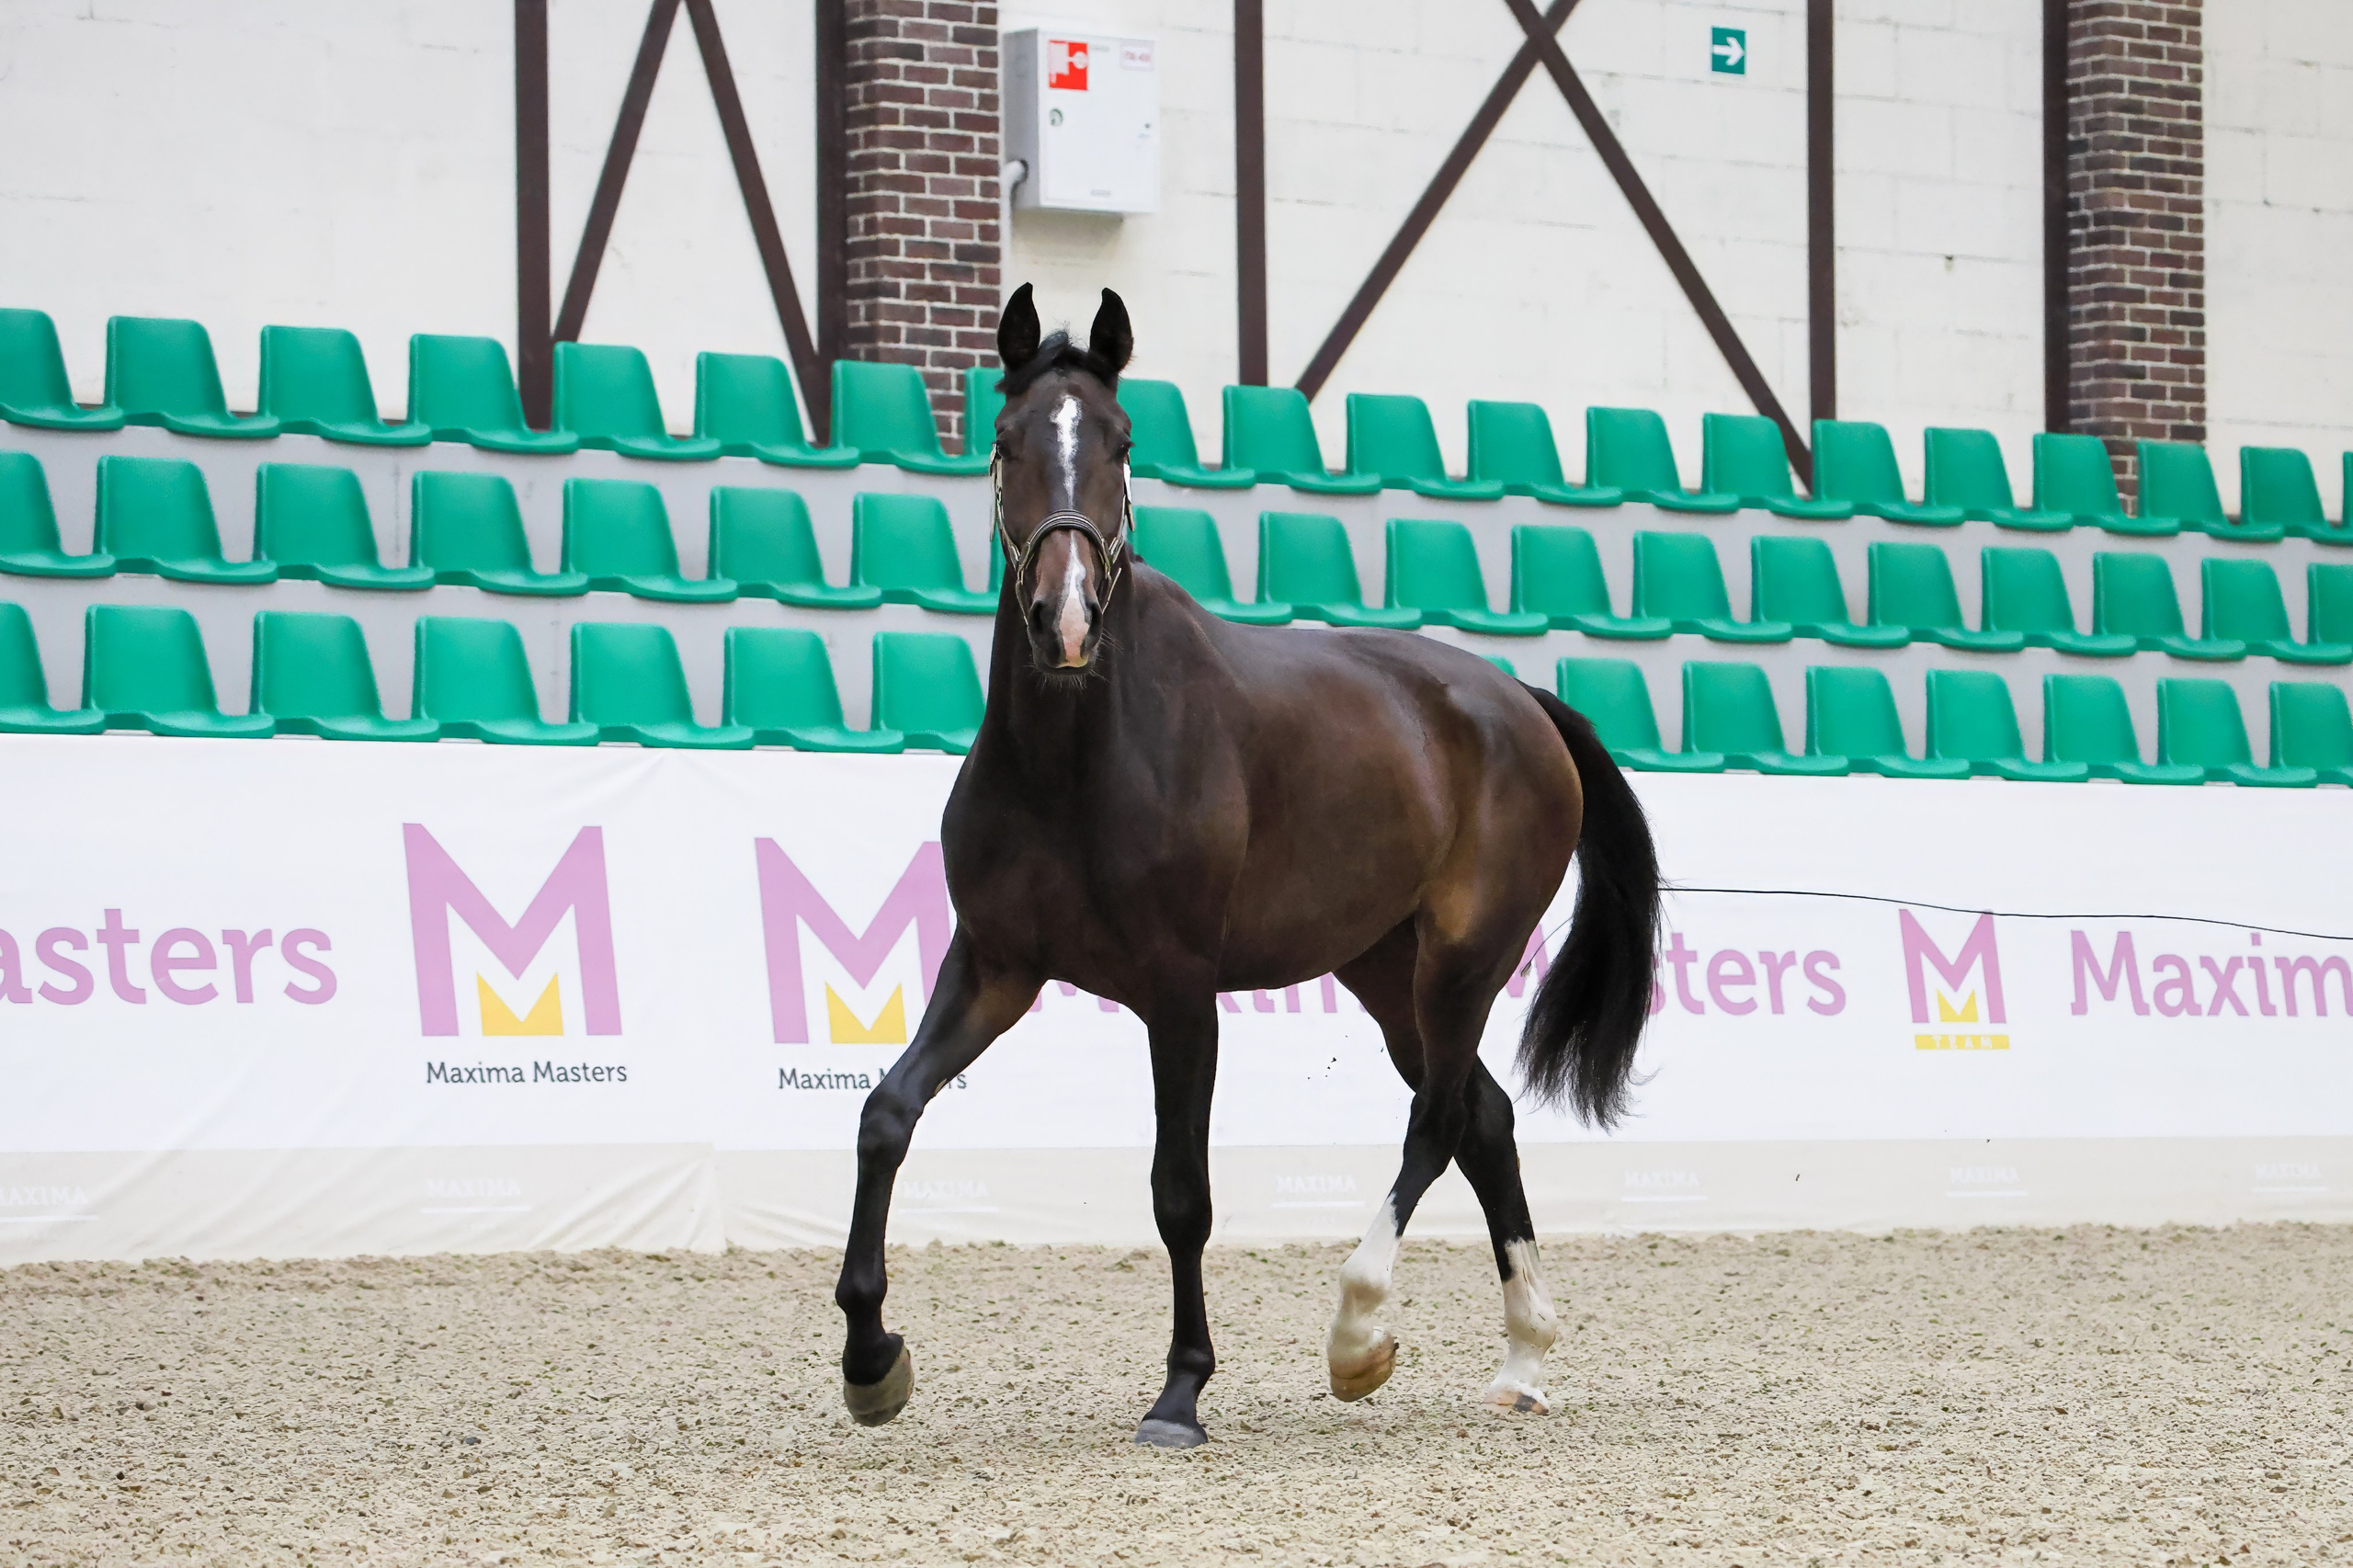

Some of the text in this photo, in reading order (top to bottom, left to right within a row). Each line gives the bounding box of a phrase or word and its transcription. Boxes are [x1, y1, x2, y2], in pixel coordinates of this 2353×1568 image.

[2070, 929, 2353, 1017] Maxim
[426, 1060, 628, 1084] Maxima Masters
[779, 1067, 871, 1090] Maxima
[1276, 1174, 1358, 1194] MAXIMA
[1623, 1170, 1700, 1187] MAXIMA
[1949, 1165, 2020, 1184] MAXIMA
[0, 1186, 89, 1206] AXIMA
[426, 1178, 522, 1198] MAXIMA
